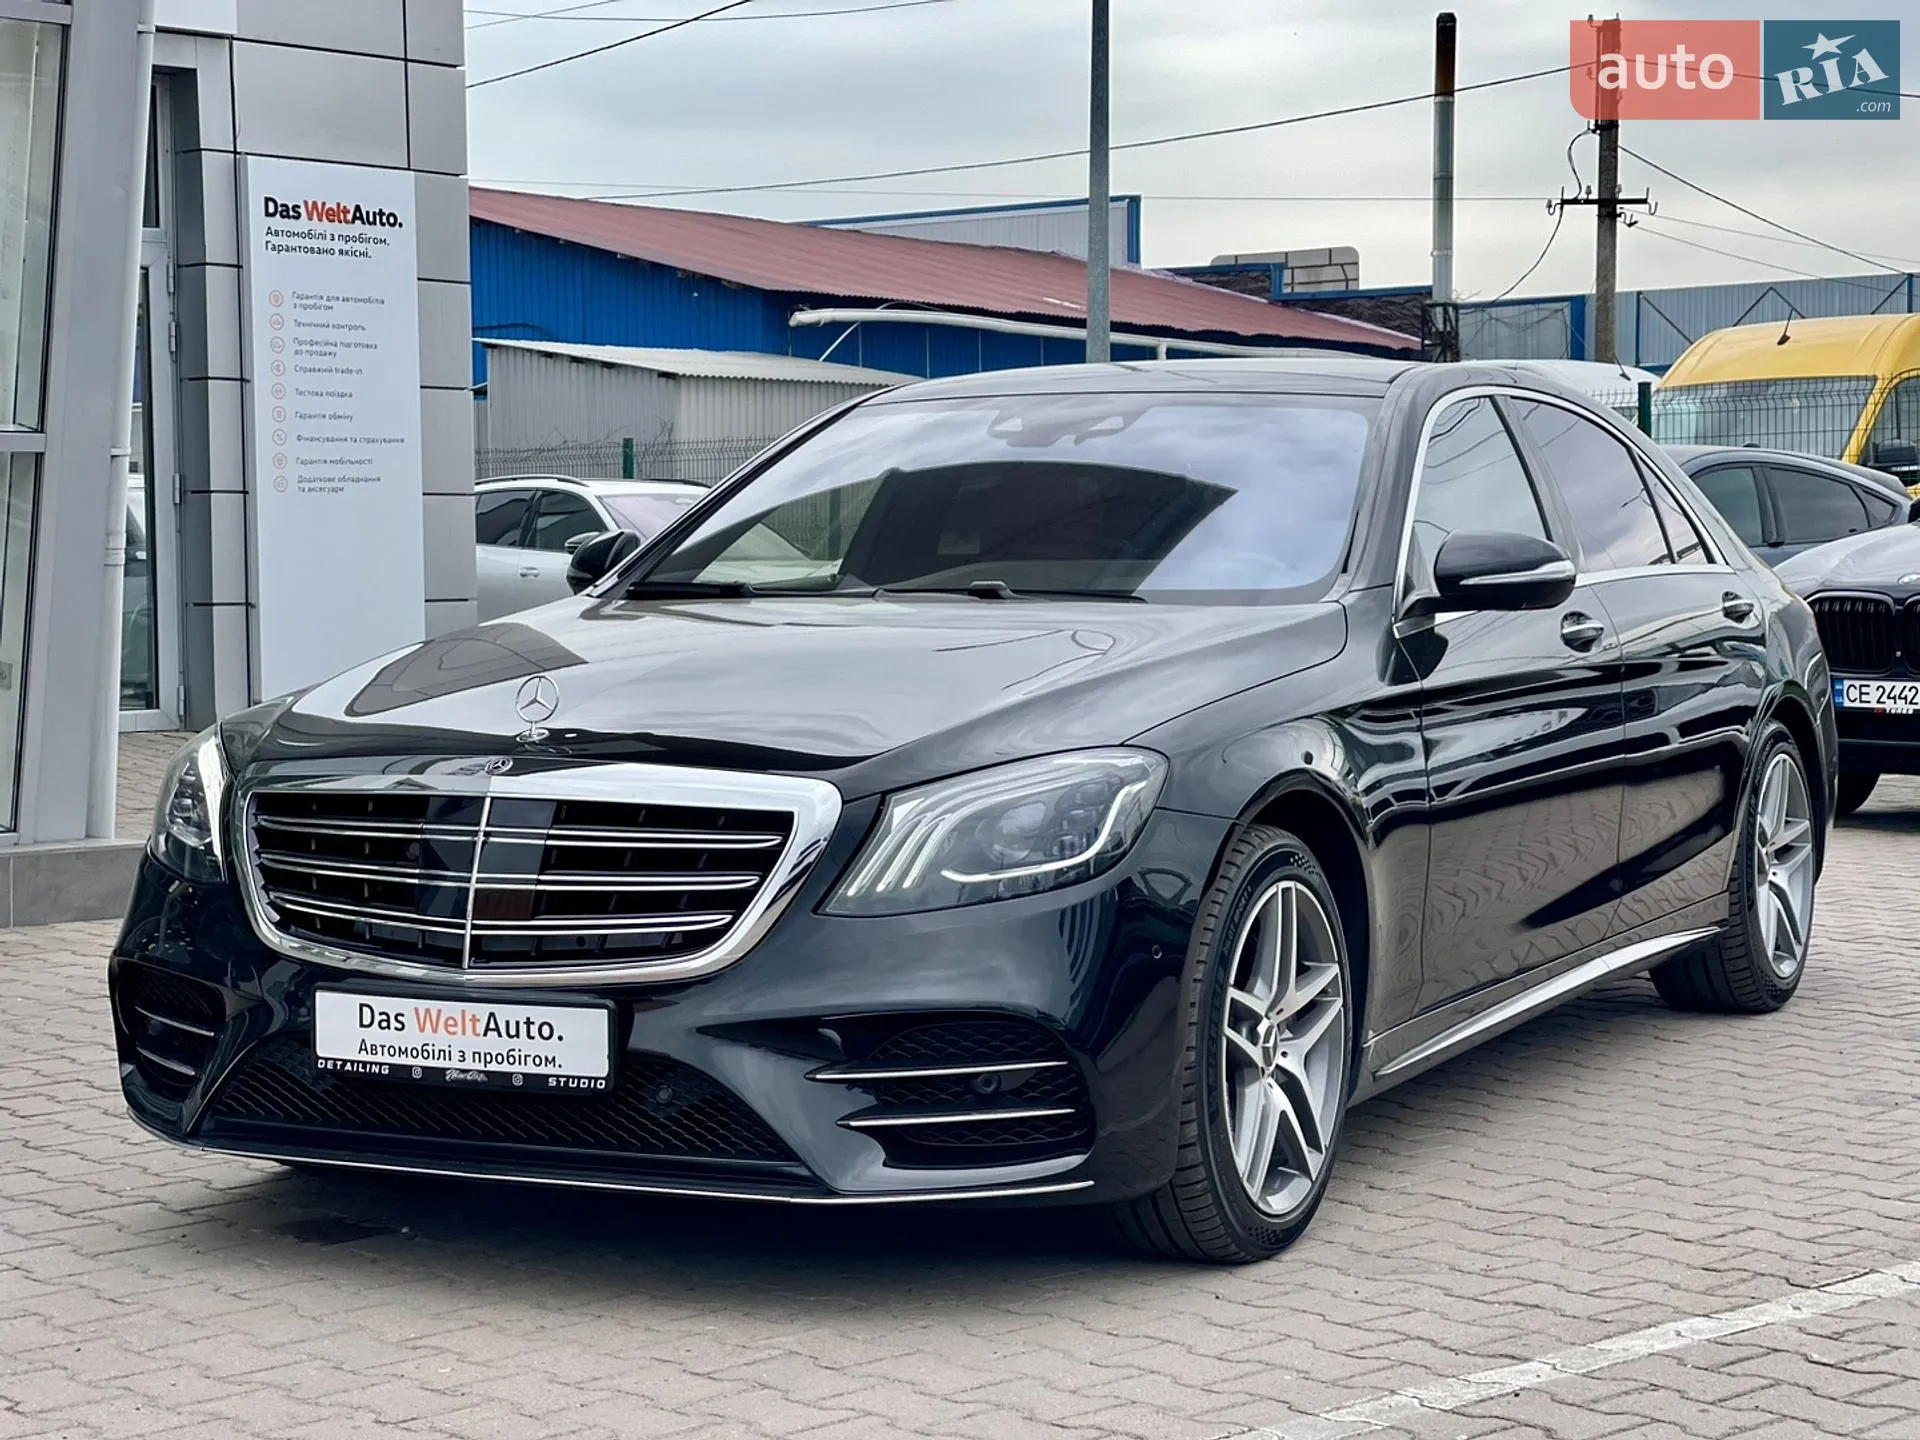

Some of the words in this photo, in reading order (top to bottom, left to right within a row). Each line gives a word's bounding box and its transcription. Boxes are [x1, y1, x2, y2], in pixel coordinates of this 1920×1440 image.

[264, 196, 302, 220] Das
[303, 200, 403, 228] WeltAuto.
[265, 226, 327, 241] Автомобілі
[329, 233, 335, 241] з
[338, 233, 390, 246] пробігом.
[265, 240, 335, 256] Гарантовано
[338, 247, 372, 259] якісні.
[292, 291, 324, 301] Гарантія
[299, 302, 334, 311] пробігом
[294, 319, 330, 329] Технічний
[332, 323, 366, 332] контроль
[293, 337, 338, 348] Професійна
[305, 349, 337, 358] продажу
[335, 367, 363, 375] trade-in
[295, 388, 323, 397] Тестова
[325, 389, 353, 398] поїздка
[295, 411, 326, 420] Гарантія
[328, 412, 353, 422] обміну
[297, 434, 348, 444] Фінансування
[359, 437, 405, 445] страхування
[296, 457, 327, 465] Гарантія
[329, 456, 373, 465] мобільності
[297, 475, 336, 484] Додаткове
[338, 475, 381, 483] обладнання
[1846, 684, 1871, 703] CE
[1875, 685, 1919, 705] 2442
[358, 1002, 406, 1032] Das
[413, 1006, 564, 1042] WeltAuto.
[358, 1038, 452, 1062] Автомобілі
[457, 1050, 466, 1062] з
[472, 1048, 563, 1068] пробігом.
[317, 1059, 390, 1075] DETAILING
[548, 1077, 606, 1090] STUDIO
